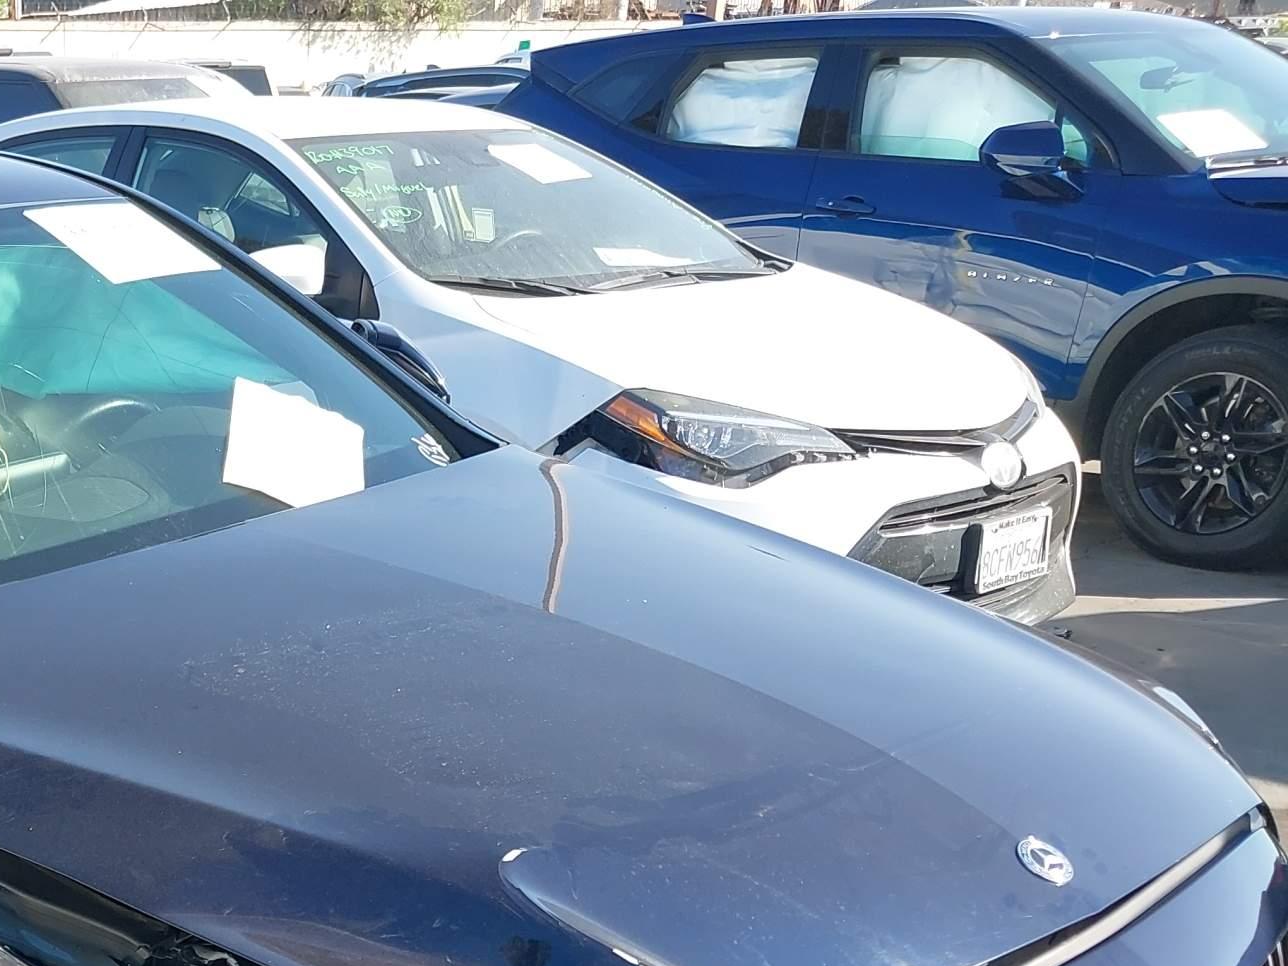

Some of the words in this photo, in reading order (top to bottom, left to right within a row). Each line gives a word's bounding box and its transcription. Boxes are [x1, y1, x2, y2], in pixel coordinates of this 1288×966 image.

[982, 577, 1004, 591] South
[1004, 573, 1019, 584] Bay
[1019, 567, 1045, 580] Toyota
